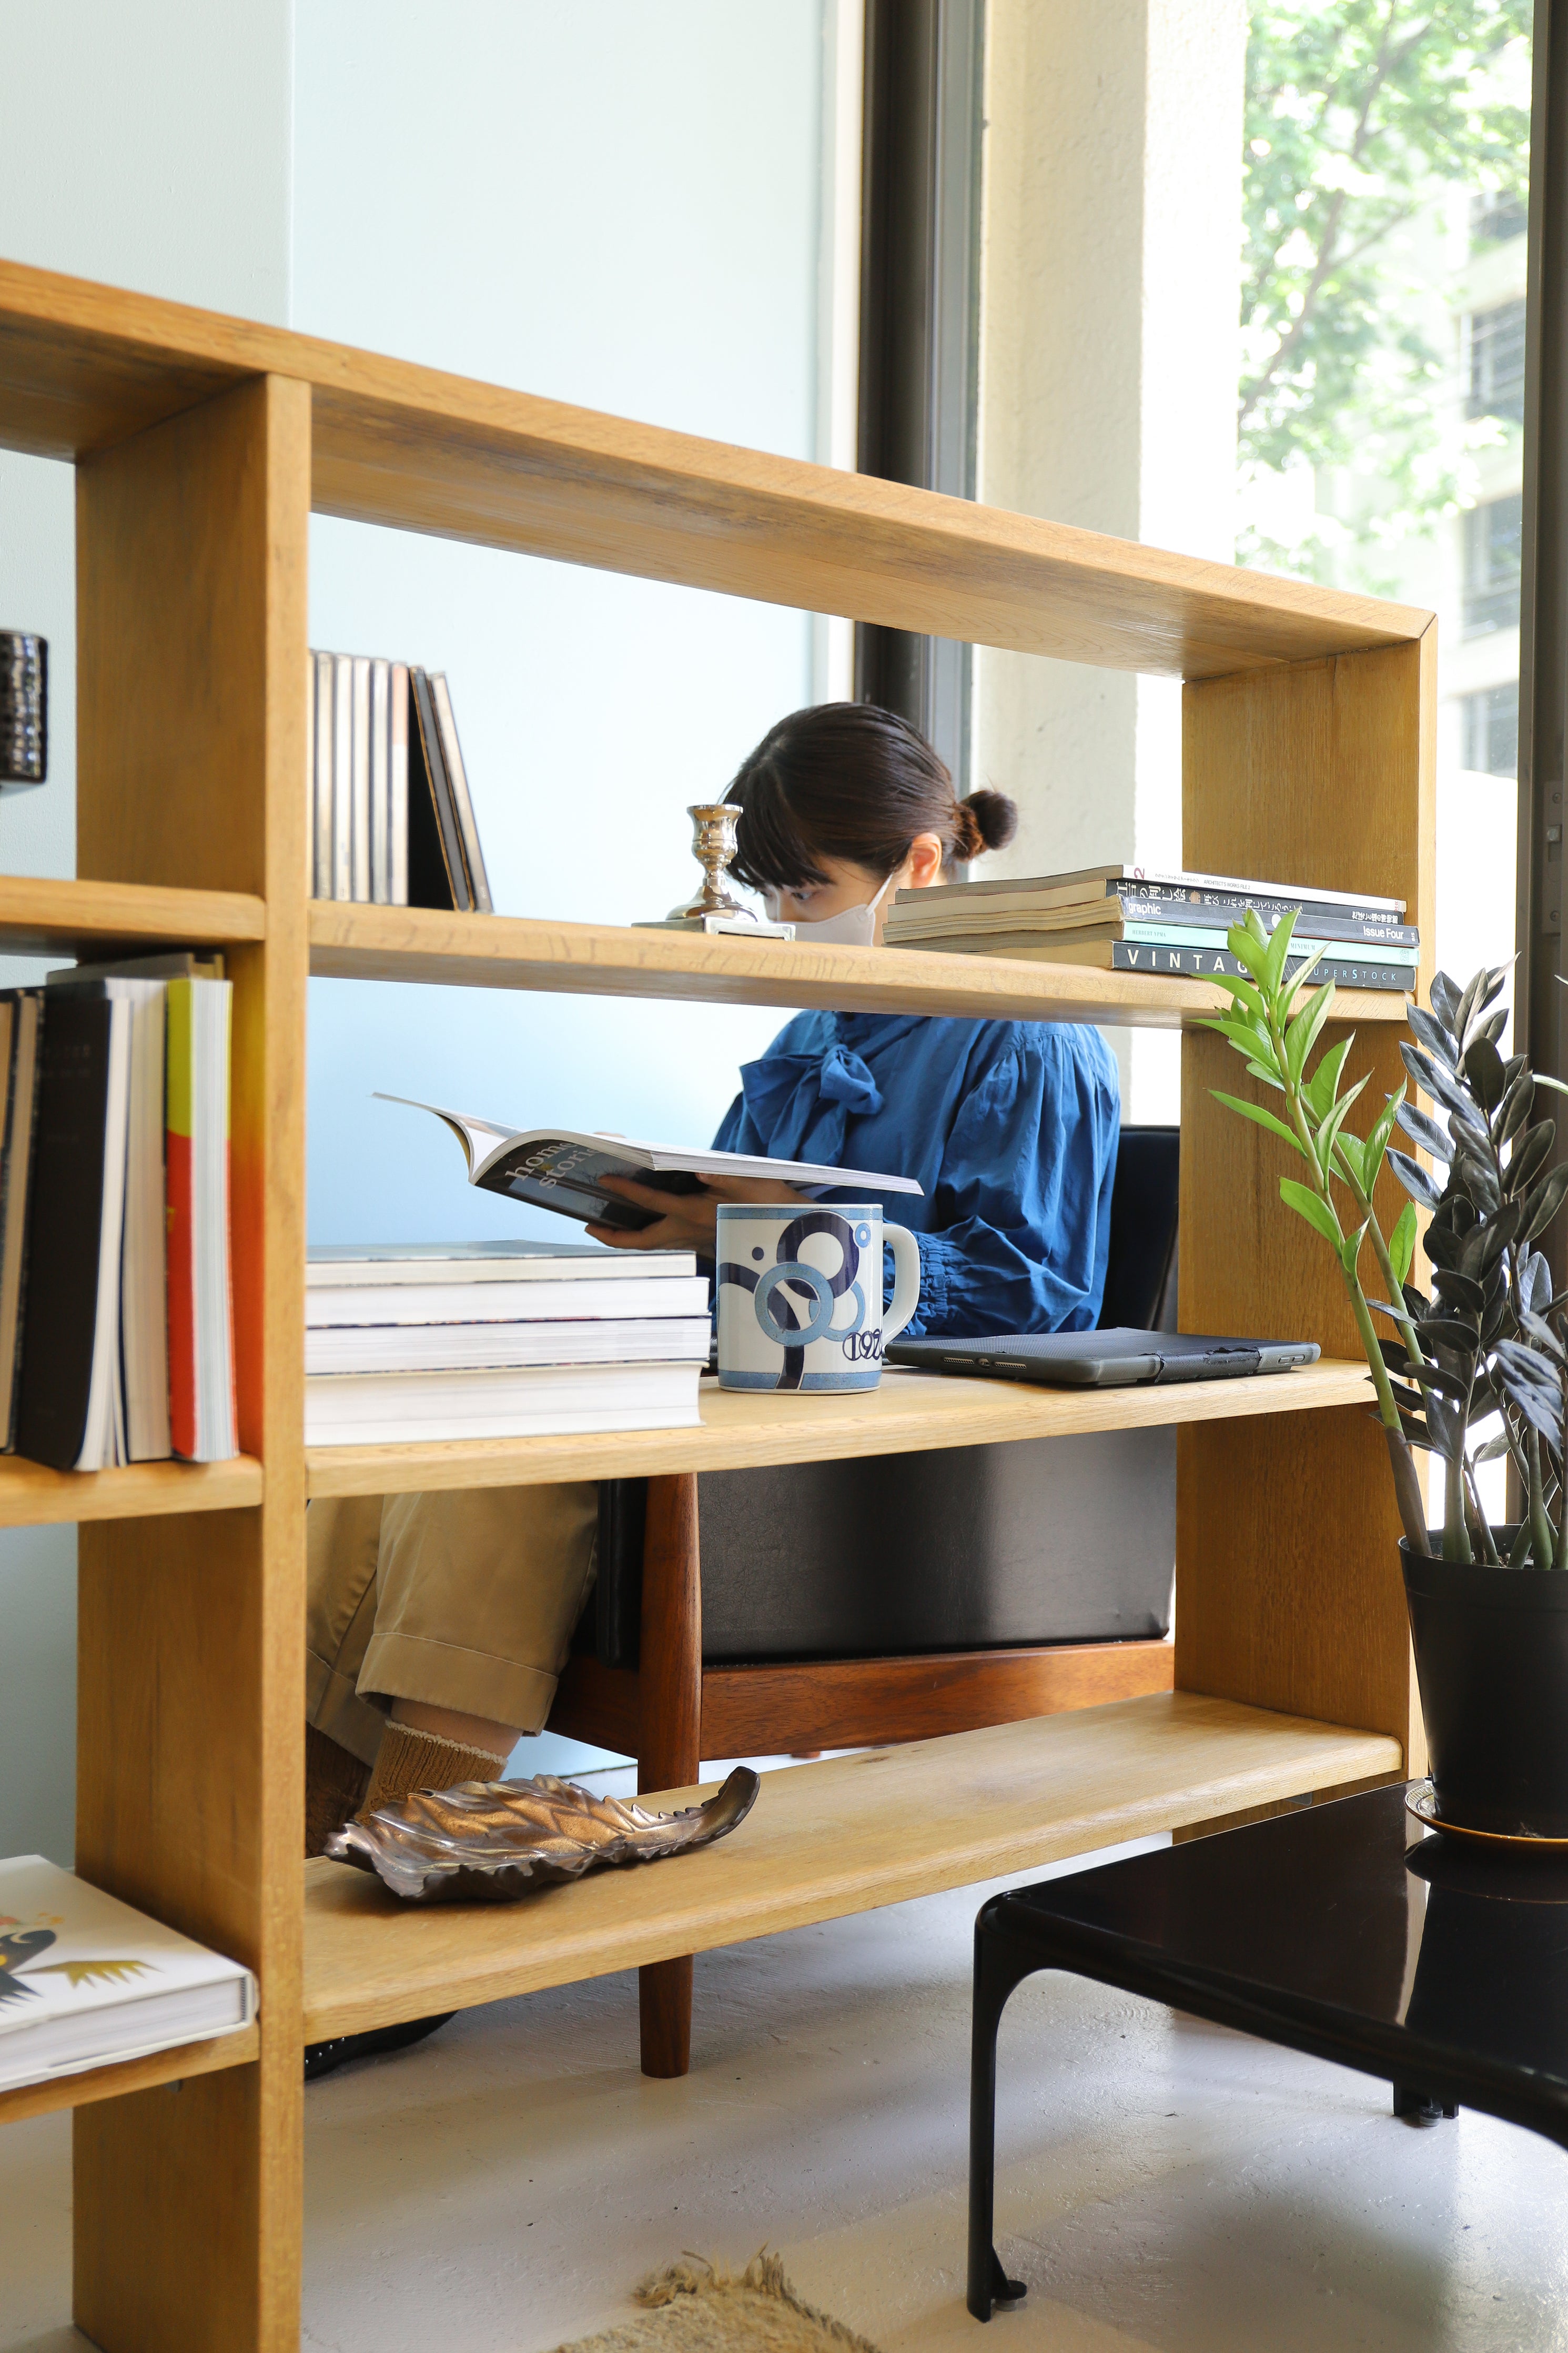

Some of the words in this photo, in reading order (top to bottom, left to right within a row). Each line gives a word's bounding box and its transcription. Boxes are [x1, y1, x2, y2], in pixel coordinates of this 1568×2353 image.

[1134, 868, 1145, 880] 2
[1128, 902, 1161, 916] graphic
[1363, 926, 1385, 938] Issue
[1386, 928, 1404, 940] Four
[1127, 949, 1248, 974] VINTAG
[1313, 968, 1397, 981] UPERSTOCK
[505, 1142, 578, 1181] home
[842, 1329, 883, 1361] 197
